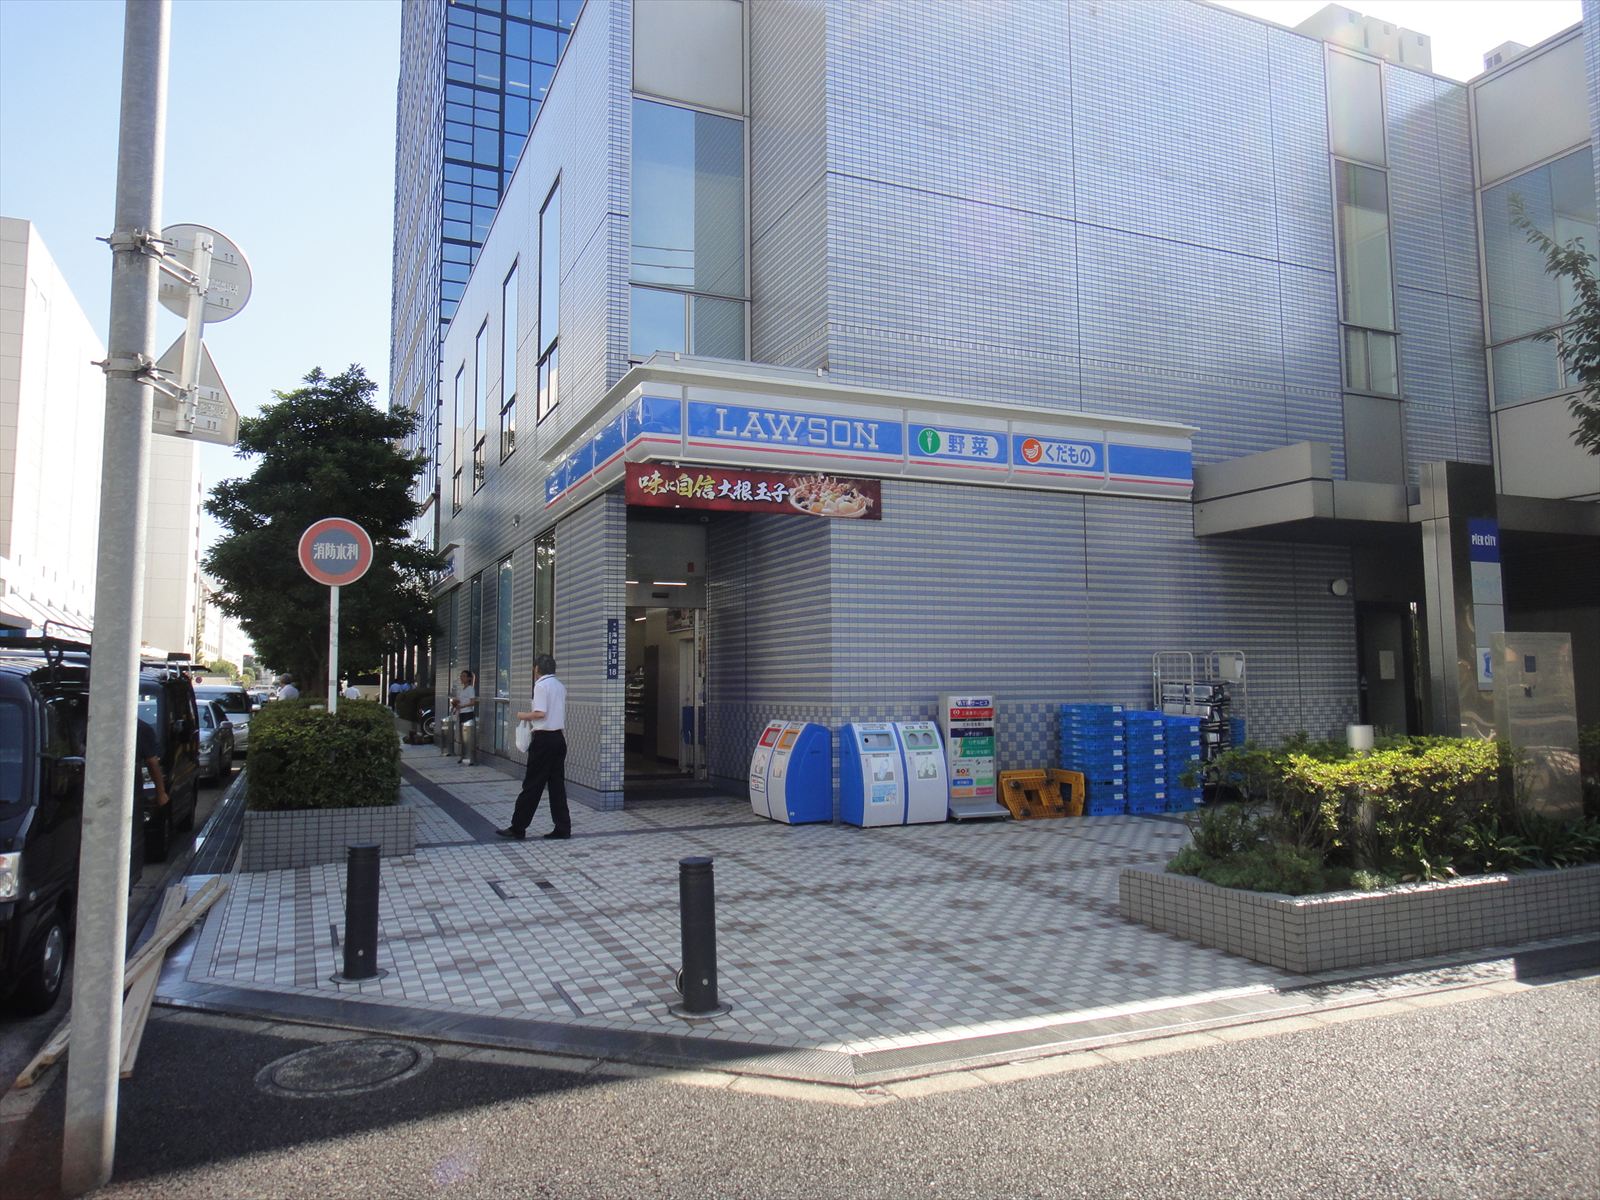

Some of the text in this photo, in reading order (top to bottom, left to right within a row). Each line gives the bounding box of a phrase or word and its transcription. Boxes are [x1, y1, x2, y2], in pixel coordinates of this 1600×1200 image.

[715, 408, 879, 449] LAWSON
[948, 434, 988, 456] 野菜
[1045, 444, 1091, 465] くだもの
[313, 542, 359, 560] 消防水利
[609, 668, 617, 676] 18
